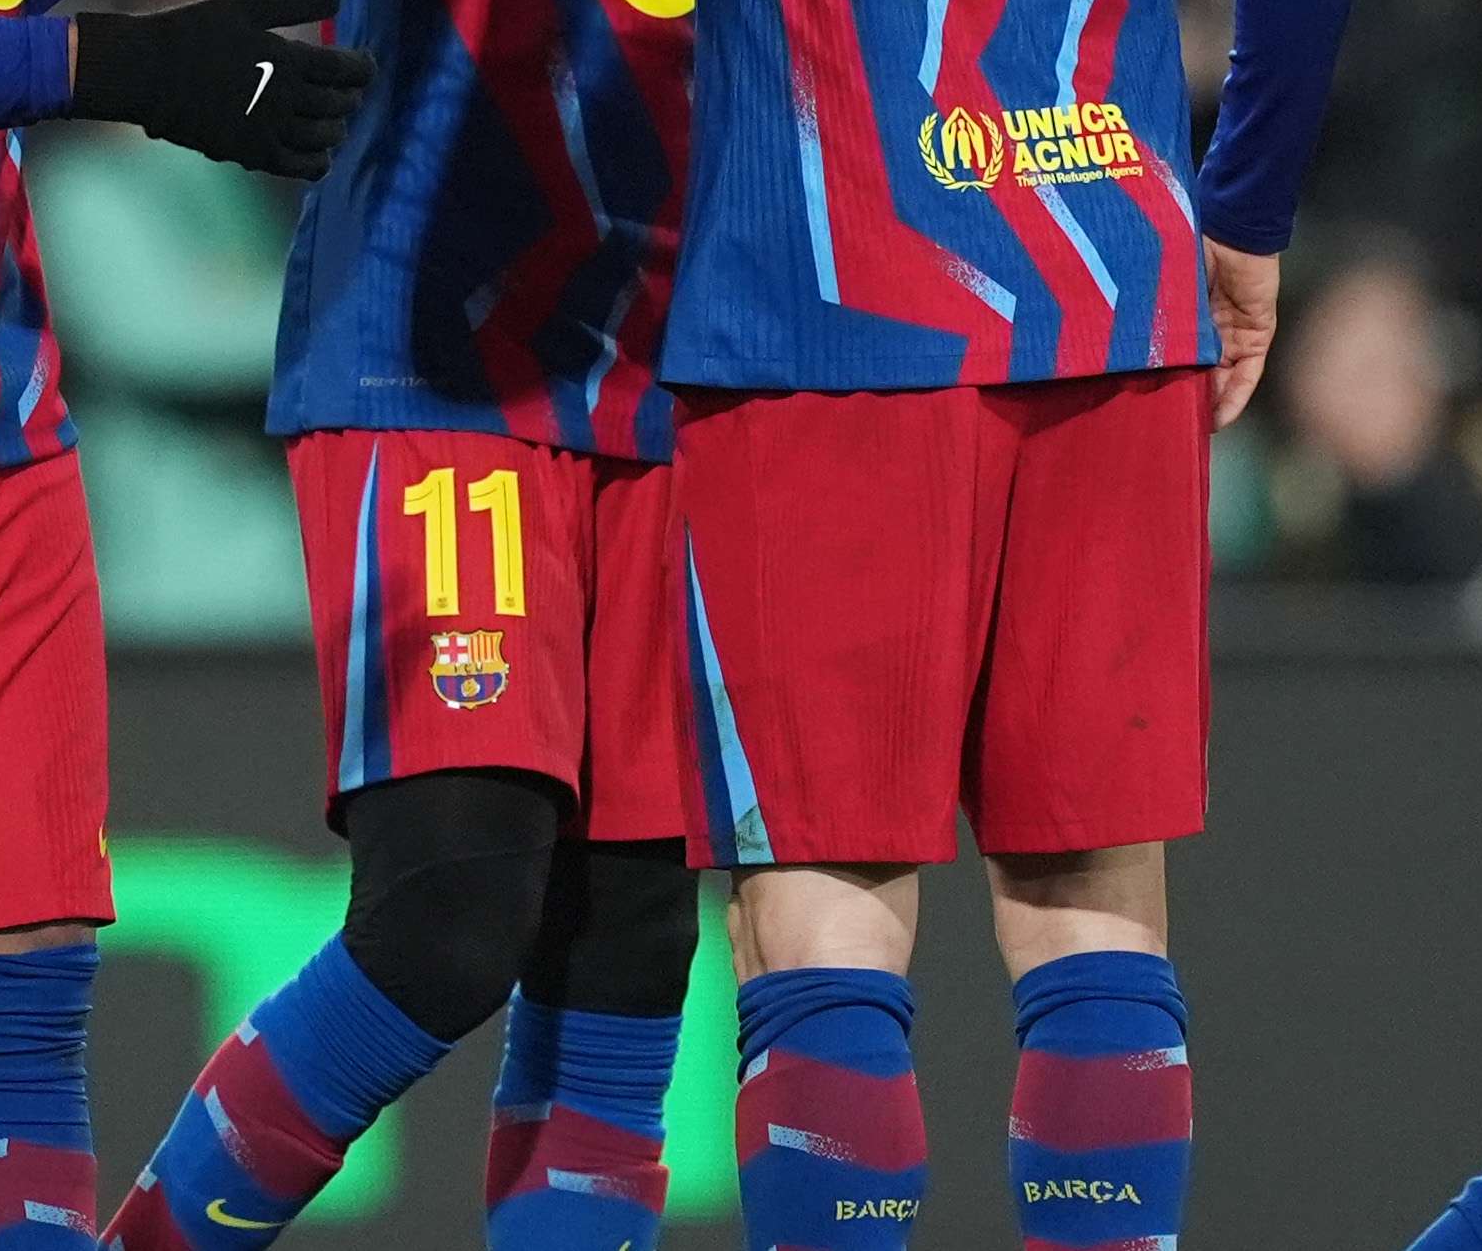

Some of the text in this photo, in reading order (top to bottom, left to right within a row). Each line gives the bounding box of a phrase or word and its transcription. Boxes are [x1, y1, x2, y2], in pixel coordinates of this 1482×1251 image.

[1001, 102, 1129, 141] UNHCR
[1013, 133, 1140, 173] ACNUR
[1015, 165, 1143, 188] The UN Refugee Agency
[404, 468, 526, 617] 11
[1024, 1180, 1141, 1205] BARÇA
